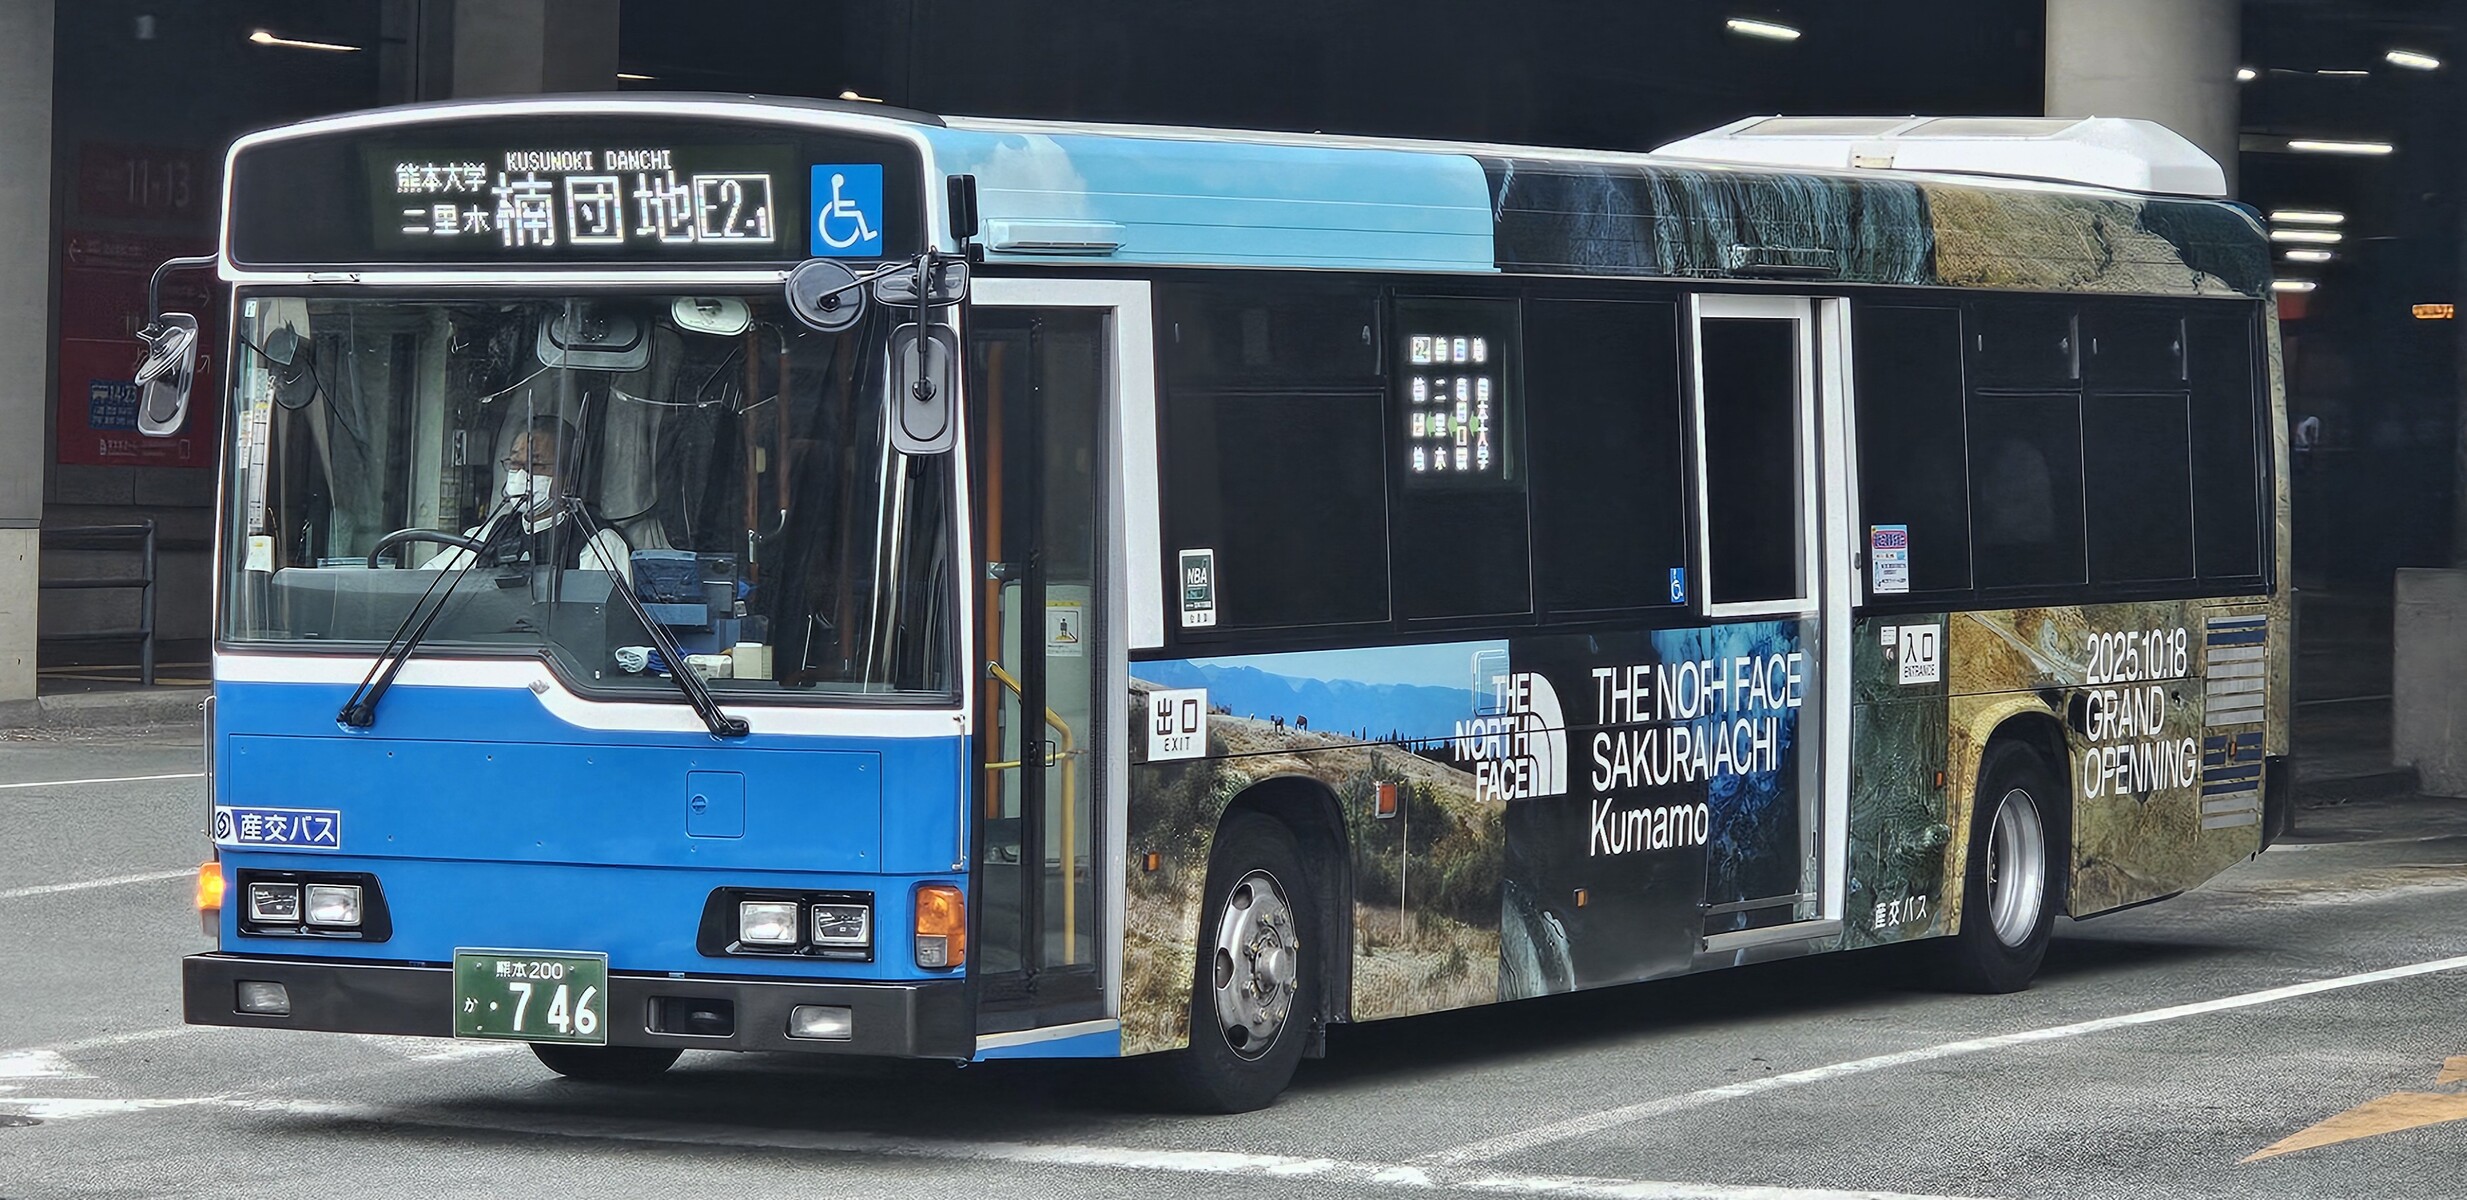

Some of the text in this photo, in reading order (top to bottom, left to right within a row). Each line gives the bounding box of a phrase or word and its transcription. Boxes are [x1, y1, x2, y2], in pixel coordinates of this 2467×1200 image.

[396, 162, 487, 193] 熊本大学
[505, 149, 672, 171] KUSUNOKI DANCHI
[401, 204, 491, 235] 二里木
[1187, 567, 1208, 584] NBA
[1905, 632, 1934, 663] 入口
[2086, 627, 2188, 685] 2025.10.18
[1492, 672, 1529, 715] THE
[1592, 664, 1651, 725] THE
[1735, 652, 1803, 713] FACE
[1156, 698, 1198, 736] 出口
[2085, 685, 2165, 742] GRAND
[1164, 737, 1191, 752] EXIT
[1454, 713, 1528, 762] NORTH
[1475, 756, 1528, 803] FACE
[2084, 737, 2197, 799] OPENNING
[240, 813, 336, 843] 産交バス
[1874, 895, 1927, 930] 産交バス
